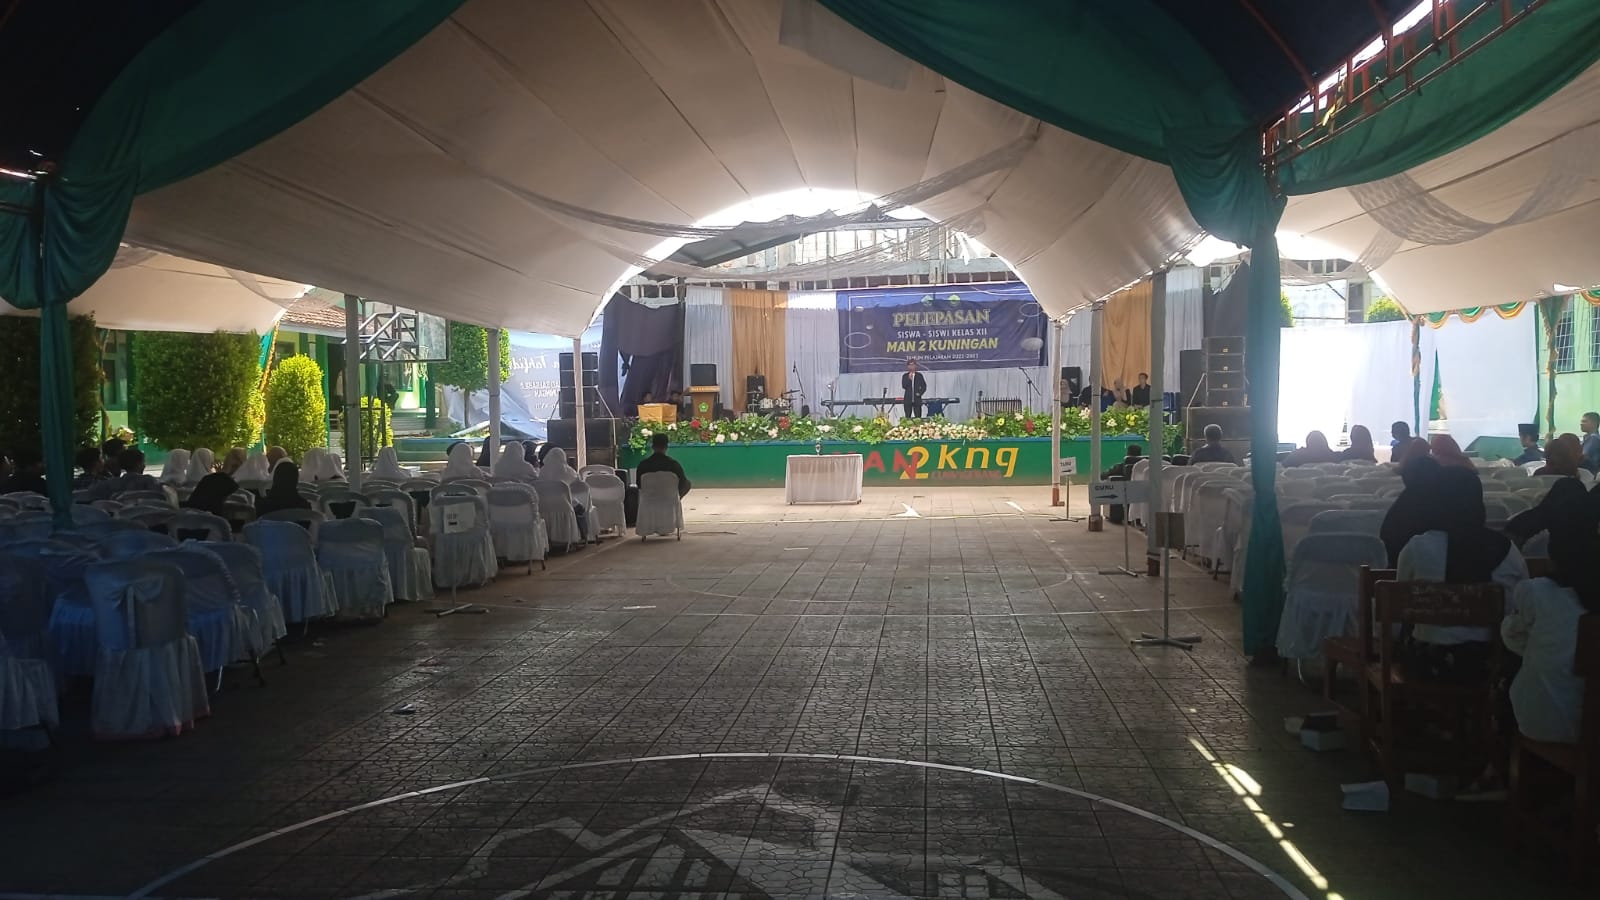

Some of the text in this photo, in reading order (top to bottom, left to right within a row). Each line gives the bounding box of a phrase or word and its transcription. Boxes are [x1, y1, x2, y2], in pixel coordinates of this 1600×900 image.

[892, 308, 991, 327] PELEPASAN
[897, 330, 921, 339] SISWA
[928, 329, 950, 338] SISWI
[952, 328, 974, 337] KELAS
[976, 327, 988, 336] XII
[886, 337, 999, 353] MAN 2 KUNINGAN
[900, 446, 929, 480] 2
